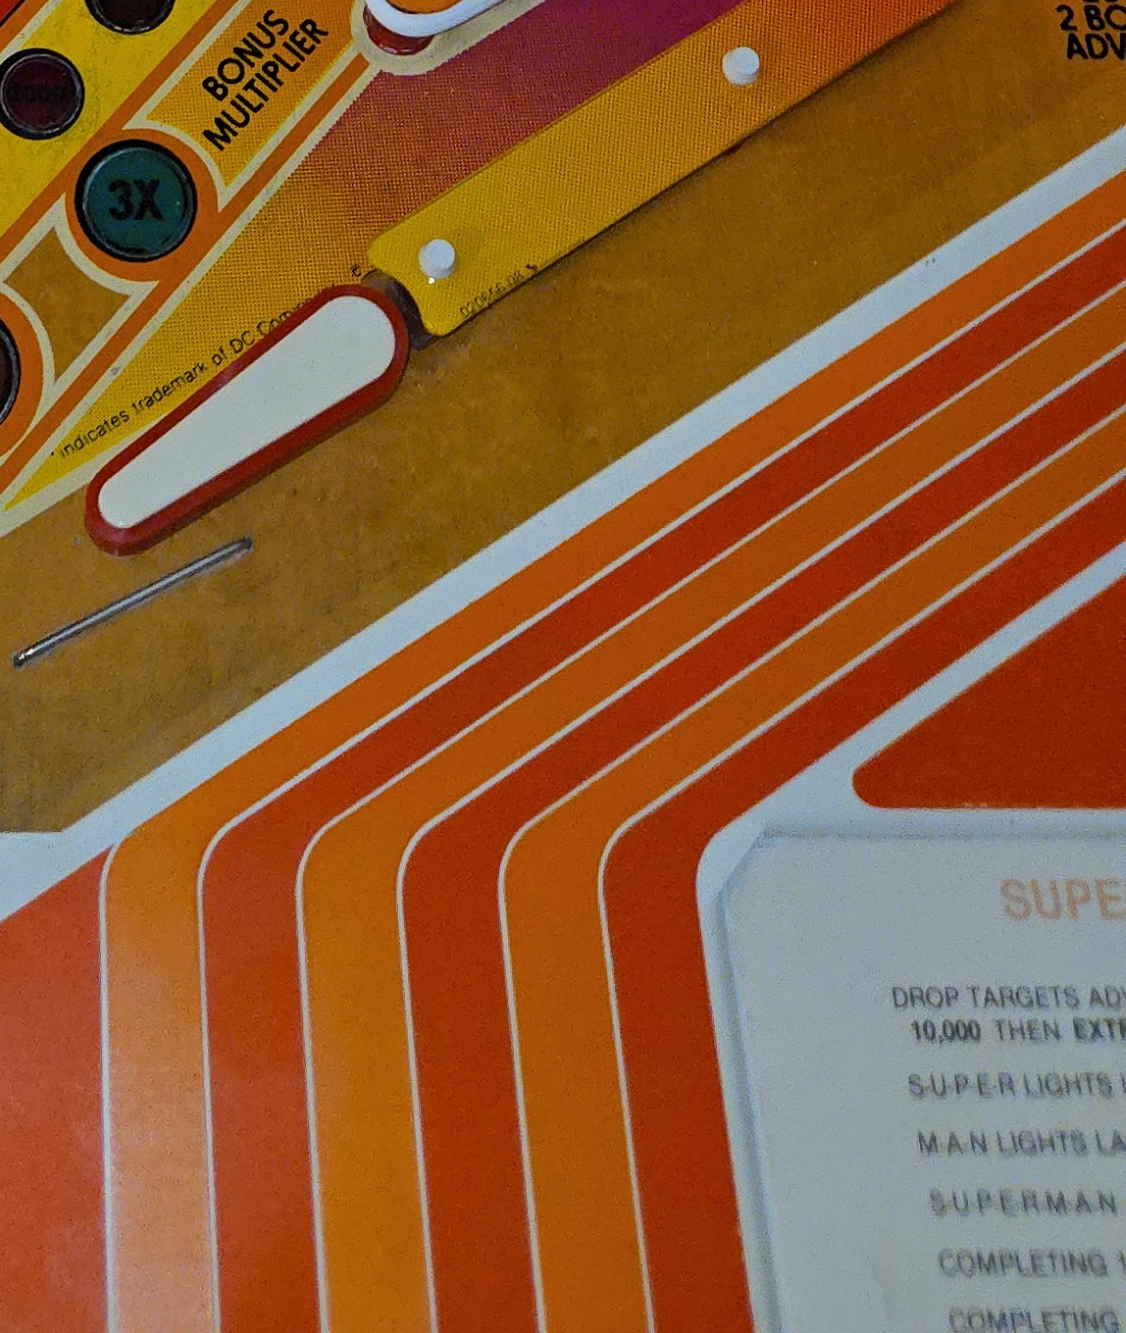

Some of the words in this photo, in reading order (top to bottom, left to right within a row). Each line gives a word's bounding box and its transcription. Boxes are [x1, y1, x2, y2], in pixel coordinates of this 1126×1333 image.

[1056, 4, 1078, 32] 2
[202, 9, 290, 103] BONUS
[202, 17, 329, 153] MULTIPLIER
[107, 179, 164, 223] 3X
[60, 410, 131, 460] indicates
[131, 362, 209, 415] trademark
[211, 347, 230, 365] of
[228, 327, 258, 355] DC
[891, 985, 960, 1009] DROP
[966, 984, 1080, 1010] TARGETS
[911, 1018, 982, 1044] 10,000
[992, 1019, 1062, 1042] THEN
[1024, 1072, 1114, 1100] LIGHTS
[996, 1130, 1089, 1157] LIGHTS
[938, 1248, 1108, 1279] COMPLETING
[948, 1305, 1121, 1333] COMPLETING
